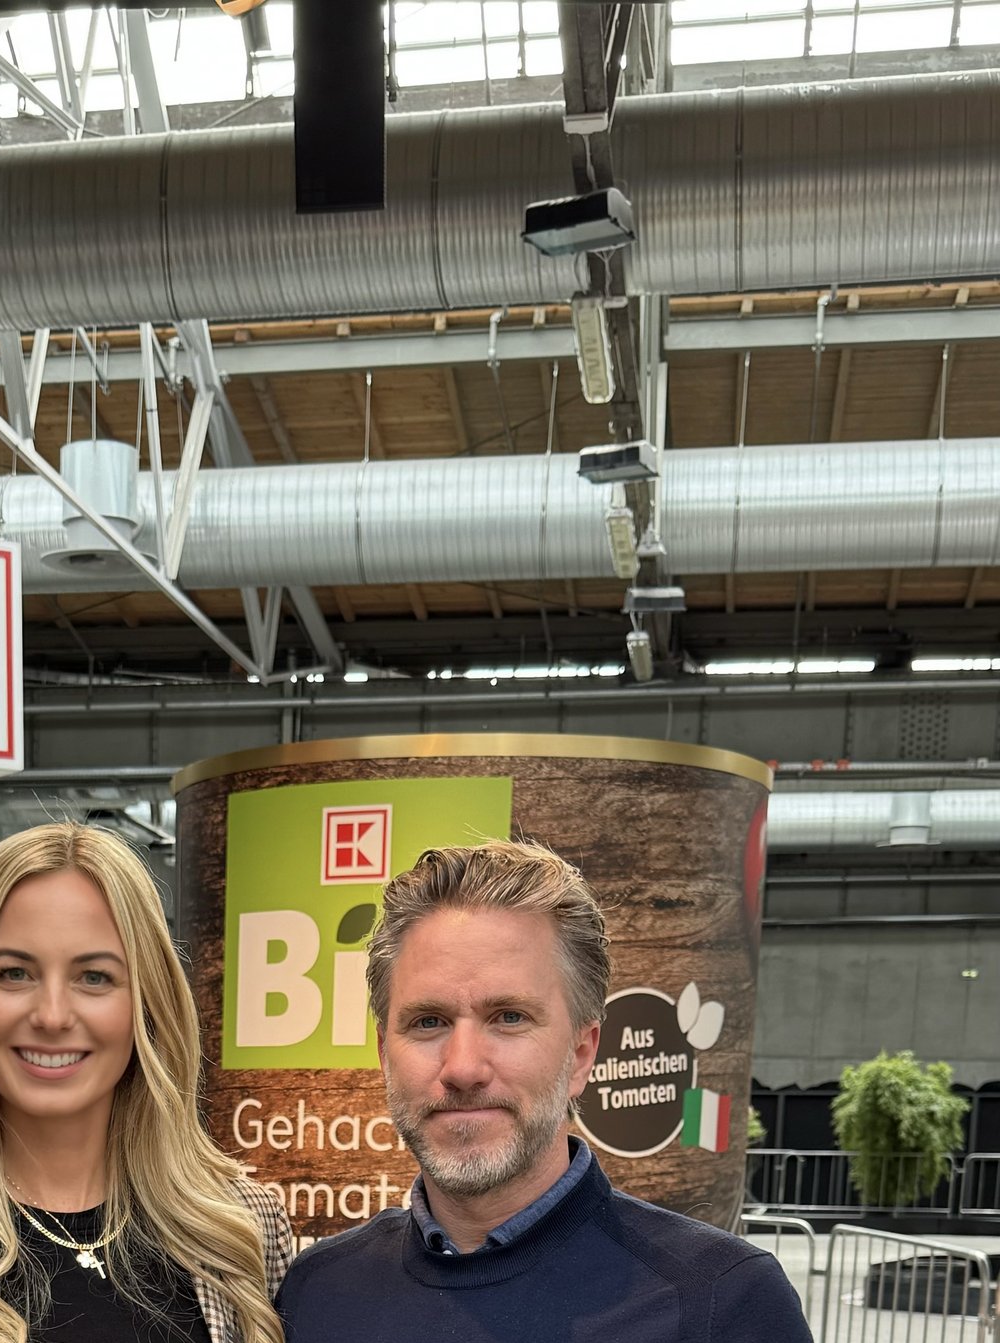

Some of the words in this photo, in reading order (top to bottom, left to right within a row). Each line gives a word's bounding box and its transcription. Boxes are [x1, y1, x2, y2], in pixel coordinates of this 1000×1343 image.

[236, 904, 373, 1047] Bi
[621, 1026, 654, 1051] Aus
[588, 1051, 688, 1083] talienischen
[598, 1083, 677, 1110] Tomaten
[233, 1098, 408, 1151] Gehac
